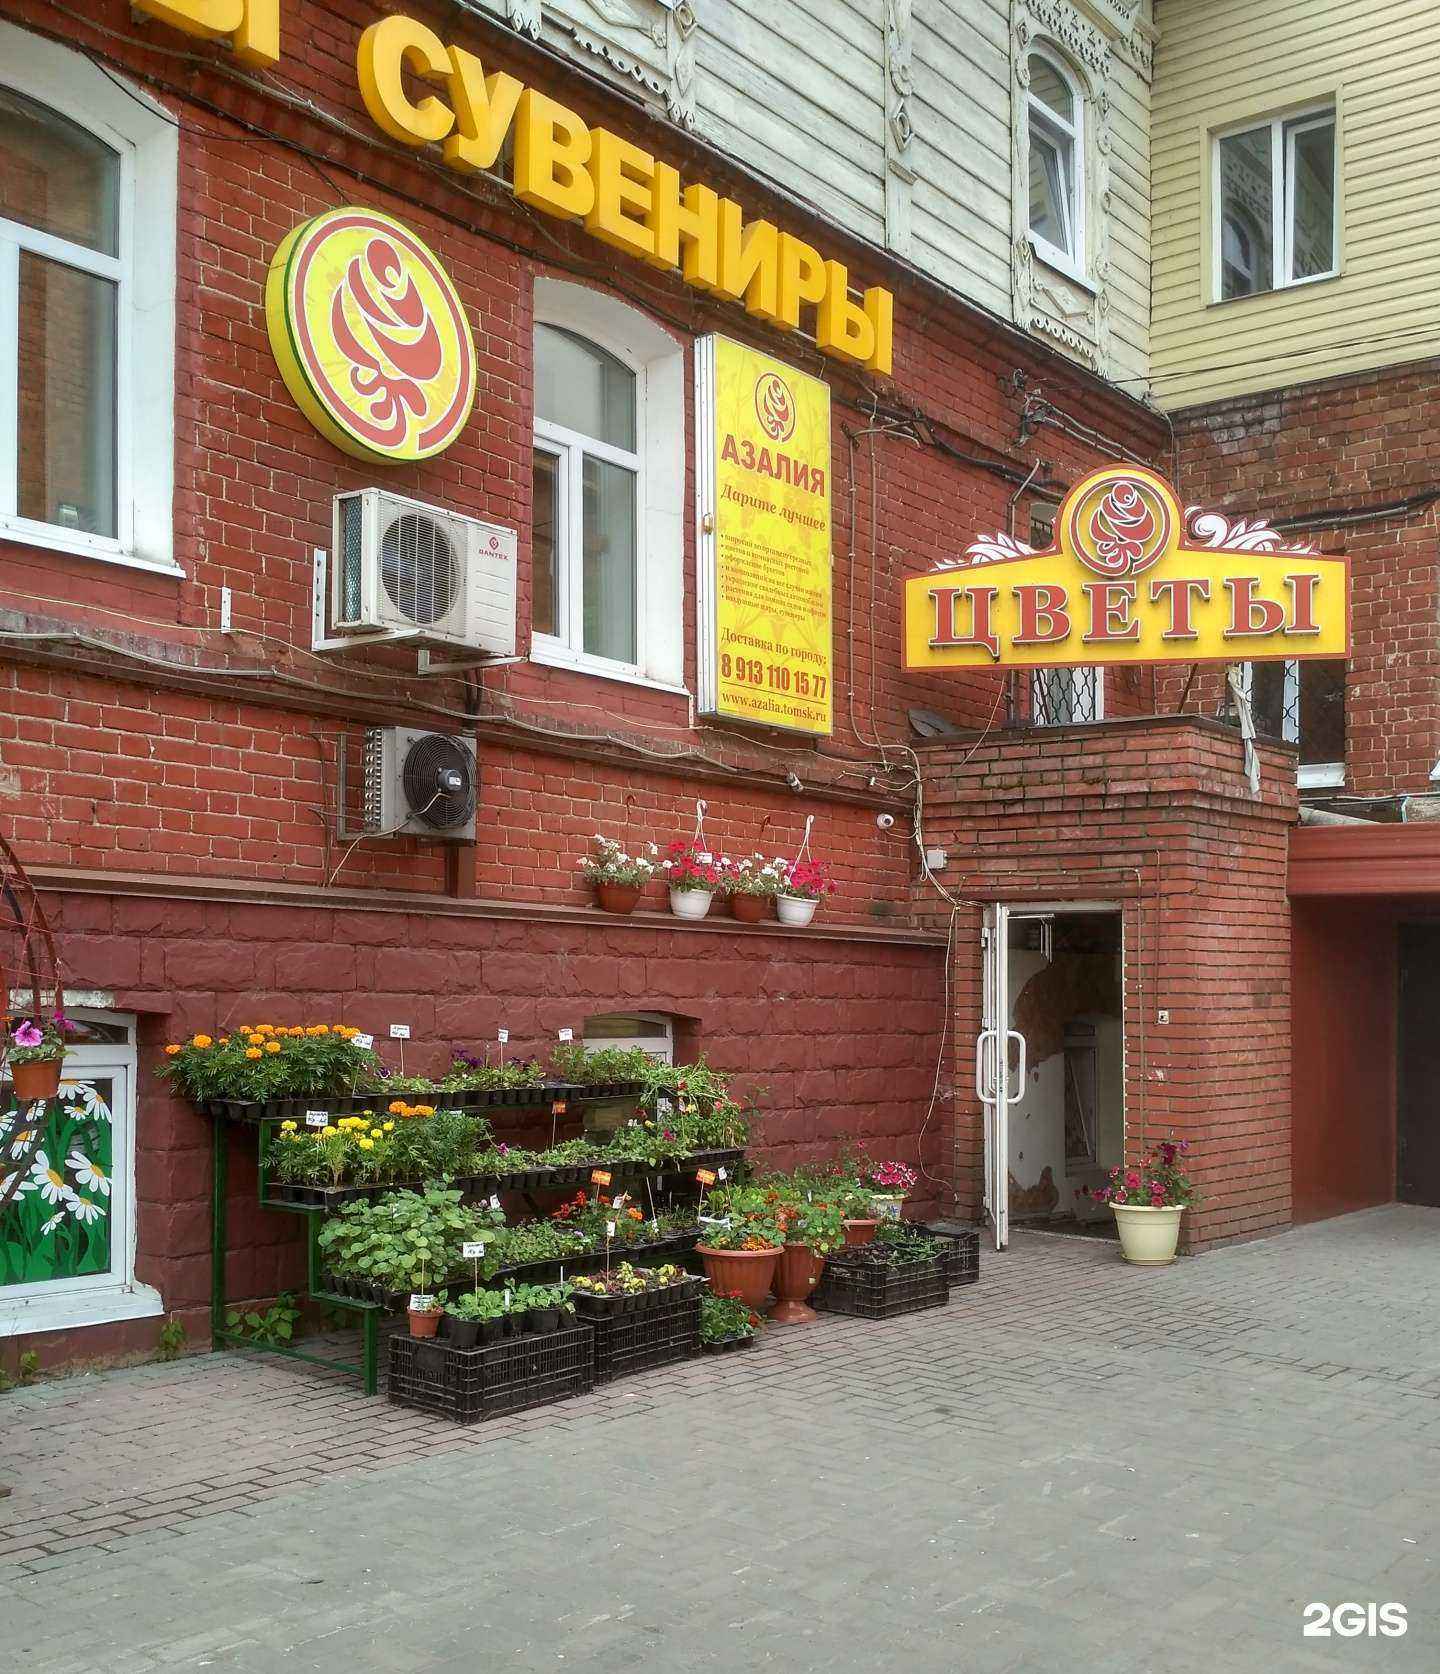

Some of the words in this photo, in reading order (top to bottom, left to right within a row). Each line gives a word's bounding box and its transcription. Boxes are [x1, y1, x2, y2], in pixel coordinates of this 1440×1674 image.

[356, 15, 893, 377] СУВЕНИРЫ
[721, 434, 825, 497] АЗАЛИЯ
[720, 484, 777, 514] Дарите
[779, 507, 826, 532] лучшее
[928, 574, 1321, 660] ЦВЕТЫ
[721, 627, 773, 652] Доставка
[776, 644, 788, 655] по
[791, 649, 827, 665] городу:
[721, 653, 732, 678] 8
[736, 656, 763, 685] 913
[767, 664, 791, 691] 110
[794, 670, 810, 695] 15
[812, 674, 826, 699] 77
[722, 692, 826, 722] www.azalia.tomsk.ru
